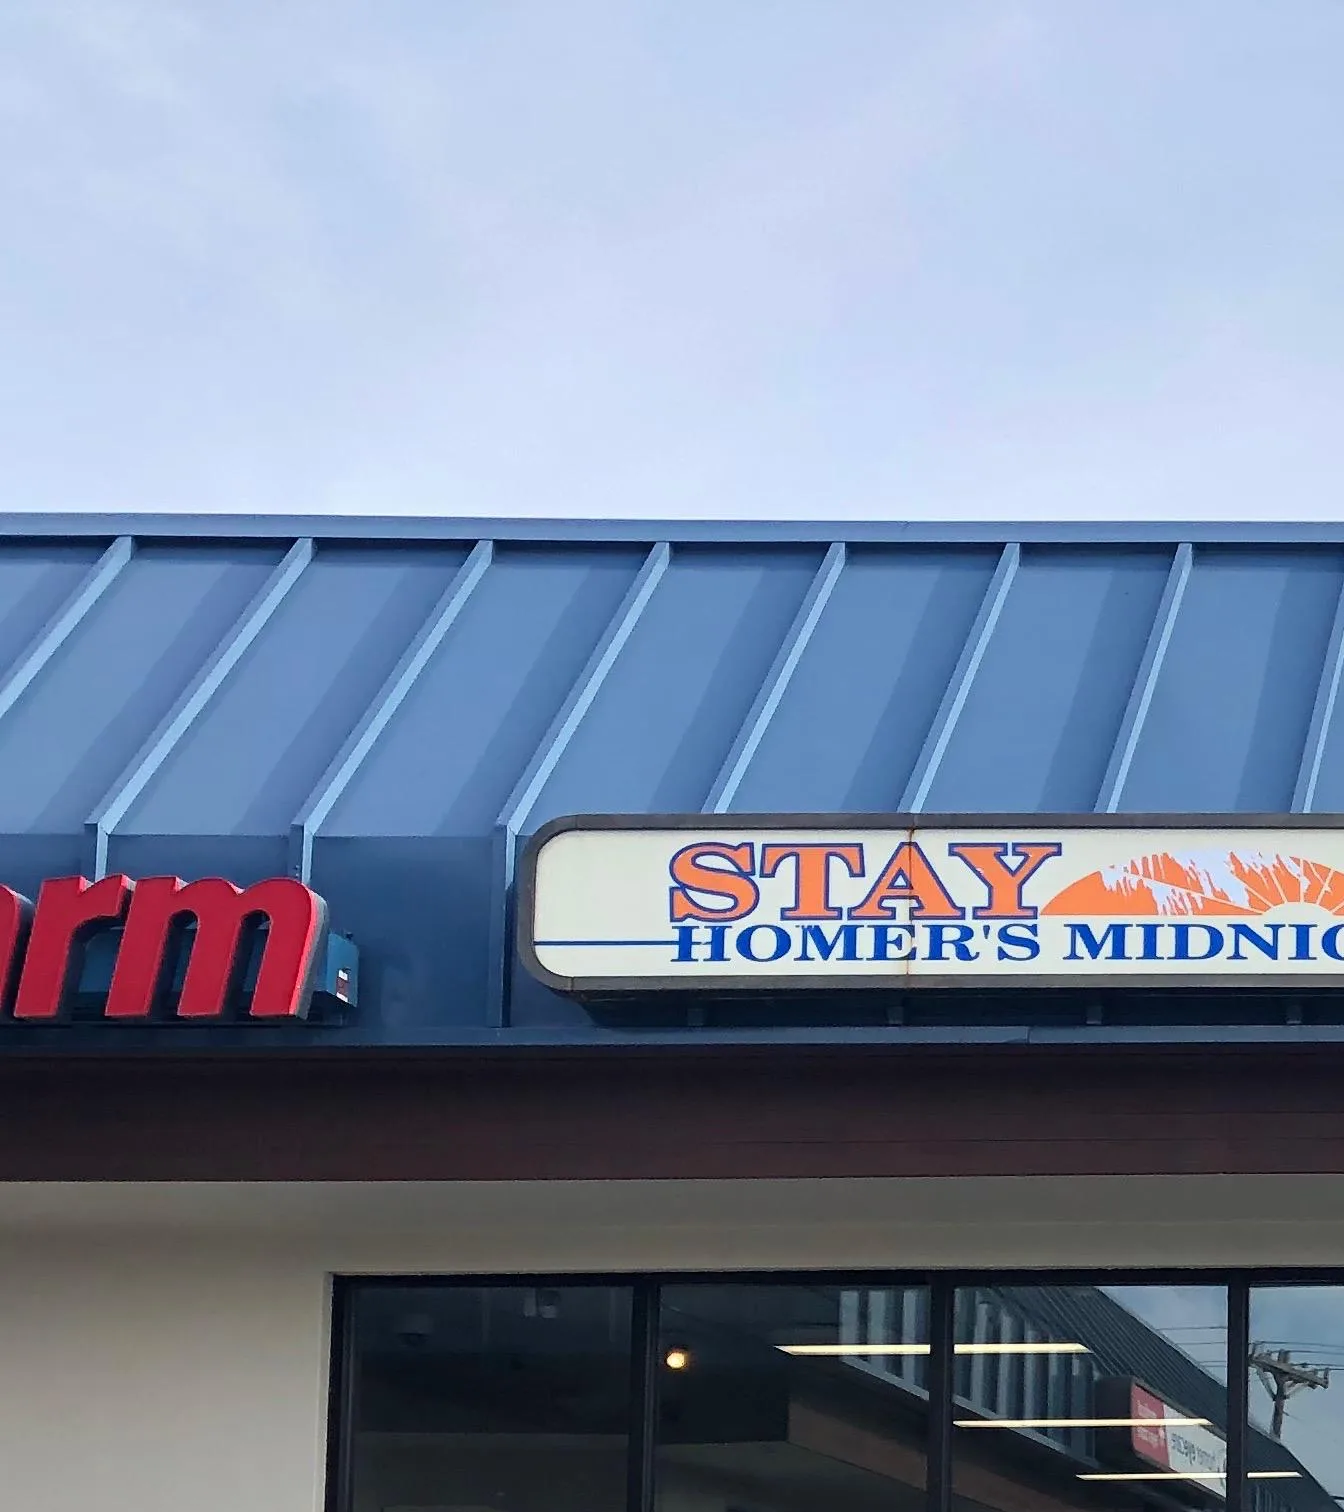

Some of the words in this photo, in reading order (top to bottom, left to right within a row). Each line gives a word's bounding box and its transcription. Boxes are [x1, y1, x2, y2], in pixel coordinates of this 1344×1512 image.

[669, 842, 1062, 922] STAY
[0, 872, 327, 1020] rm
[670, 923, 1041, 962] HOMER'S
